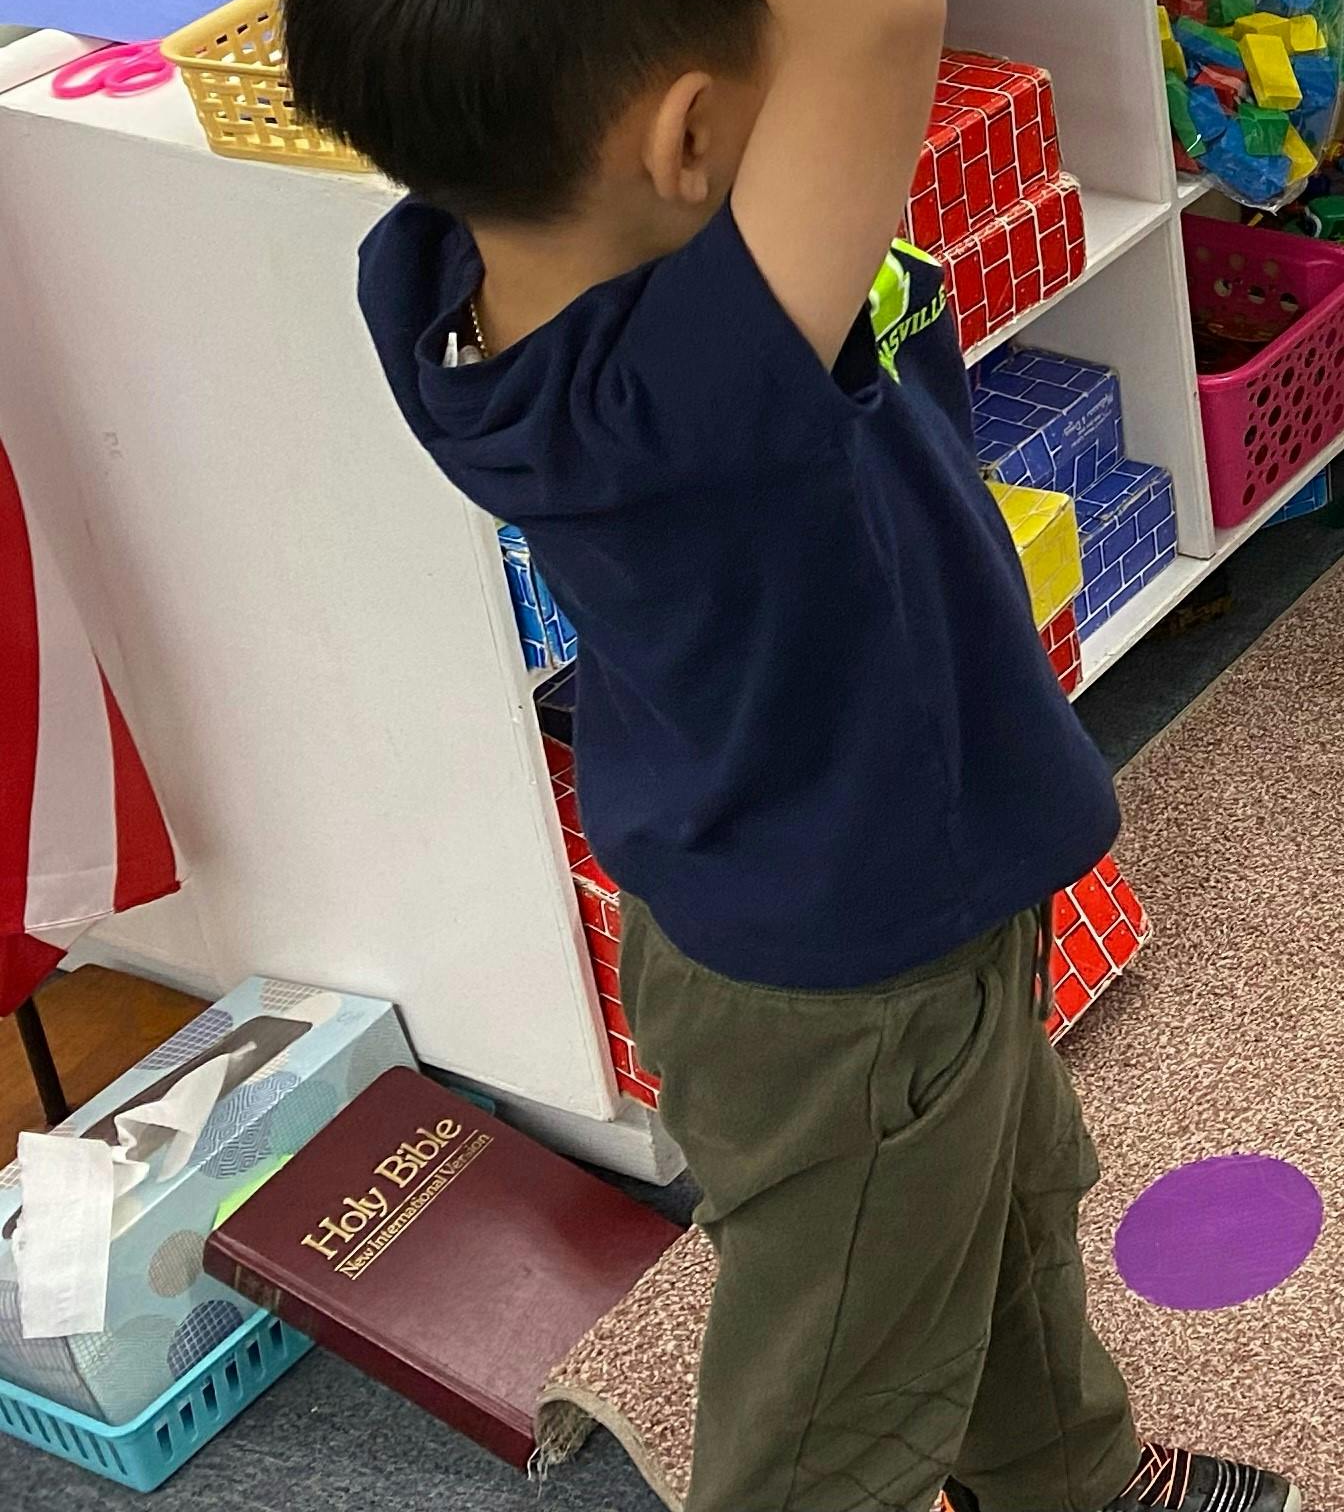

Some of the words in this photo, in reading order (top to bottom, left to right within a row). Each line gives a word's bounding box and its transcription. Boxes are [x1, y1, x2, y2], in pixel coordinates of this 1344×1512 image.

[301, 1186, 388, 1261] Holy
[373, 1118, 462, 1188] Bible
[339, 1248, 374, 1278] New
[372, 1172, 448, 1250] International
[440, 1133, 490, 1176] Version
